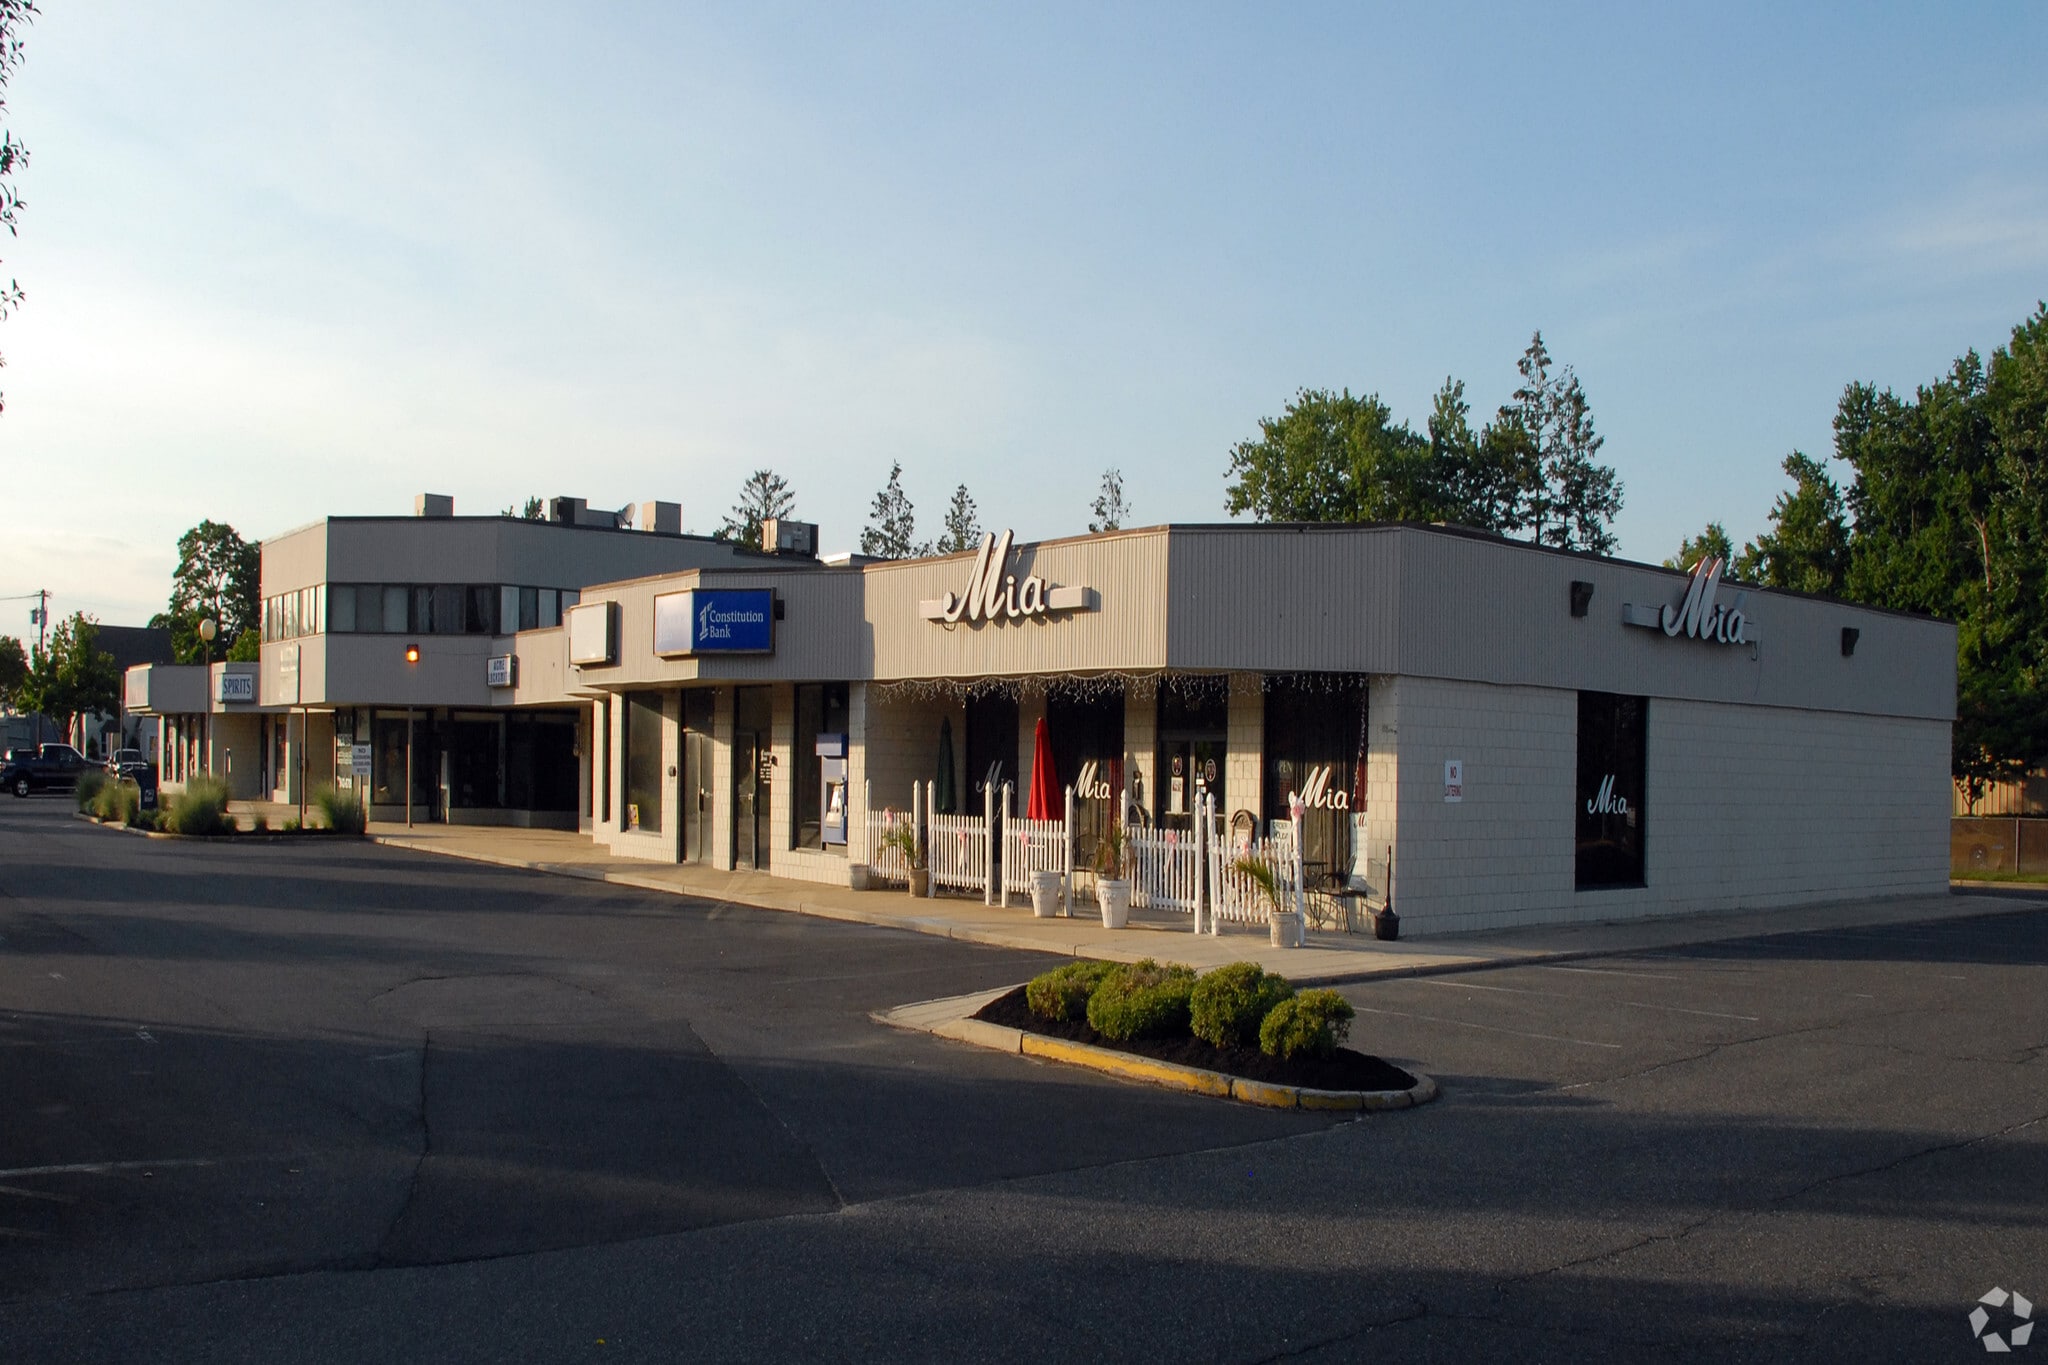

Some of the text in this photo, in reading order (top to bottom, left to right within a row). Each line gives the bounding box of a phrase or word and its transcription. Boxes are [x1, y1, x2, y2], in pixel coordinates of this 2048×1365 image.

[943, 528, 1046, 622] Mia
[709, 610, 764, 623] Constitution
[1661, 556, 1746, 644] Mia
[709, 624, 732, 638] Bank
[224, 678, 252, 694] SPIRITS
[1071, 761, 1111, 799] Mia
[1288, 766, 1349, 810] Mia
[1450, 766, 1458, 778] NO
[1587, 774, 1628, 815] Mia
